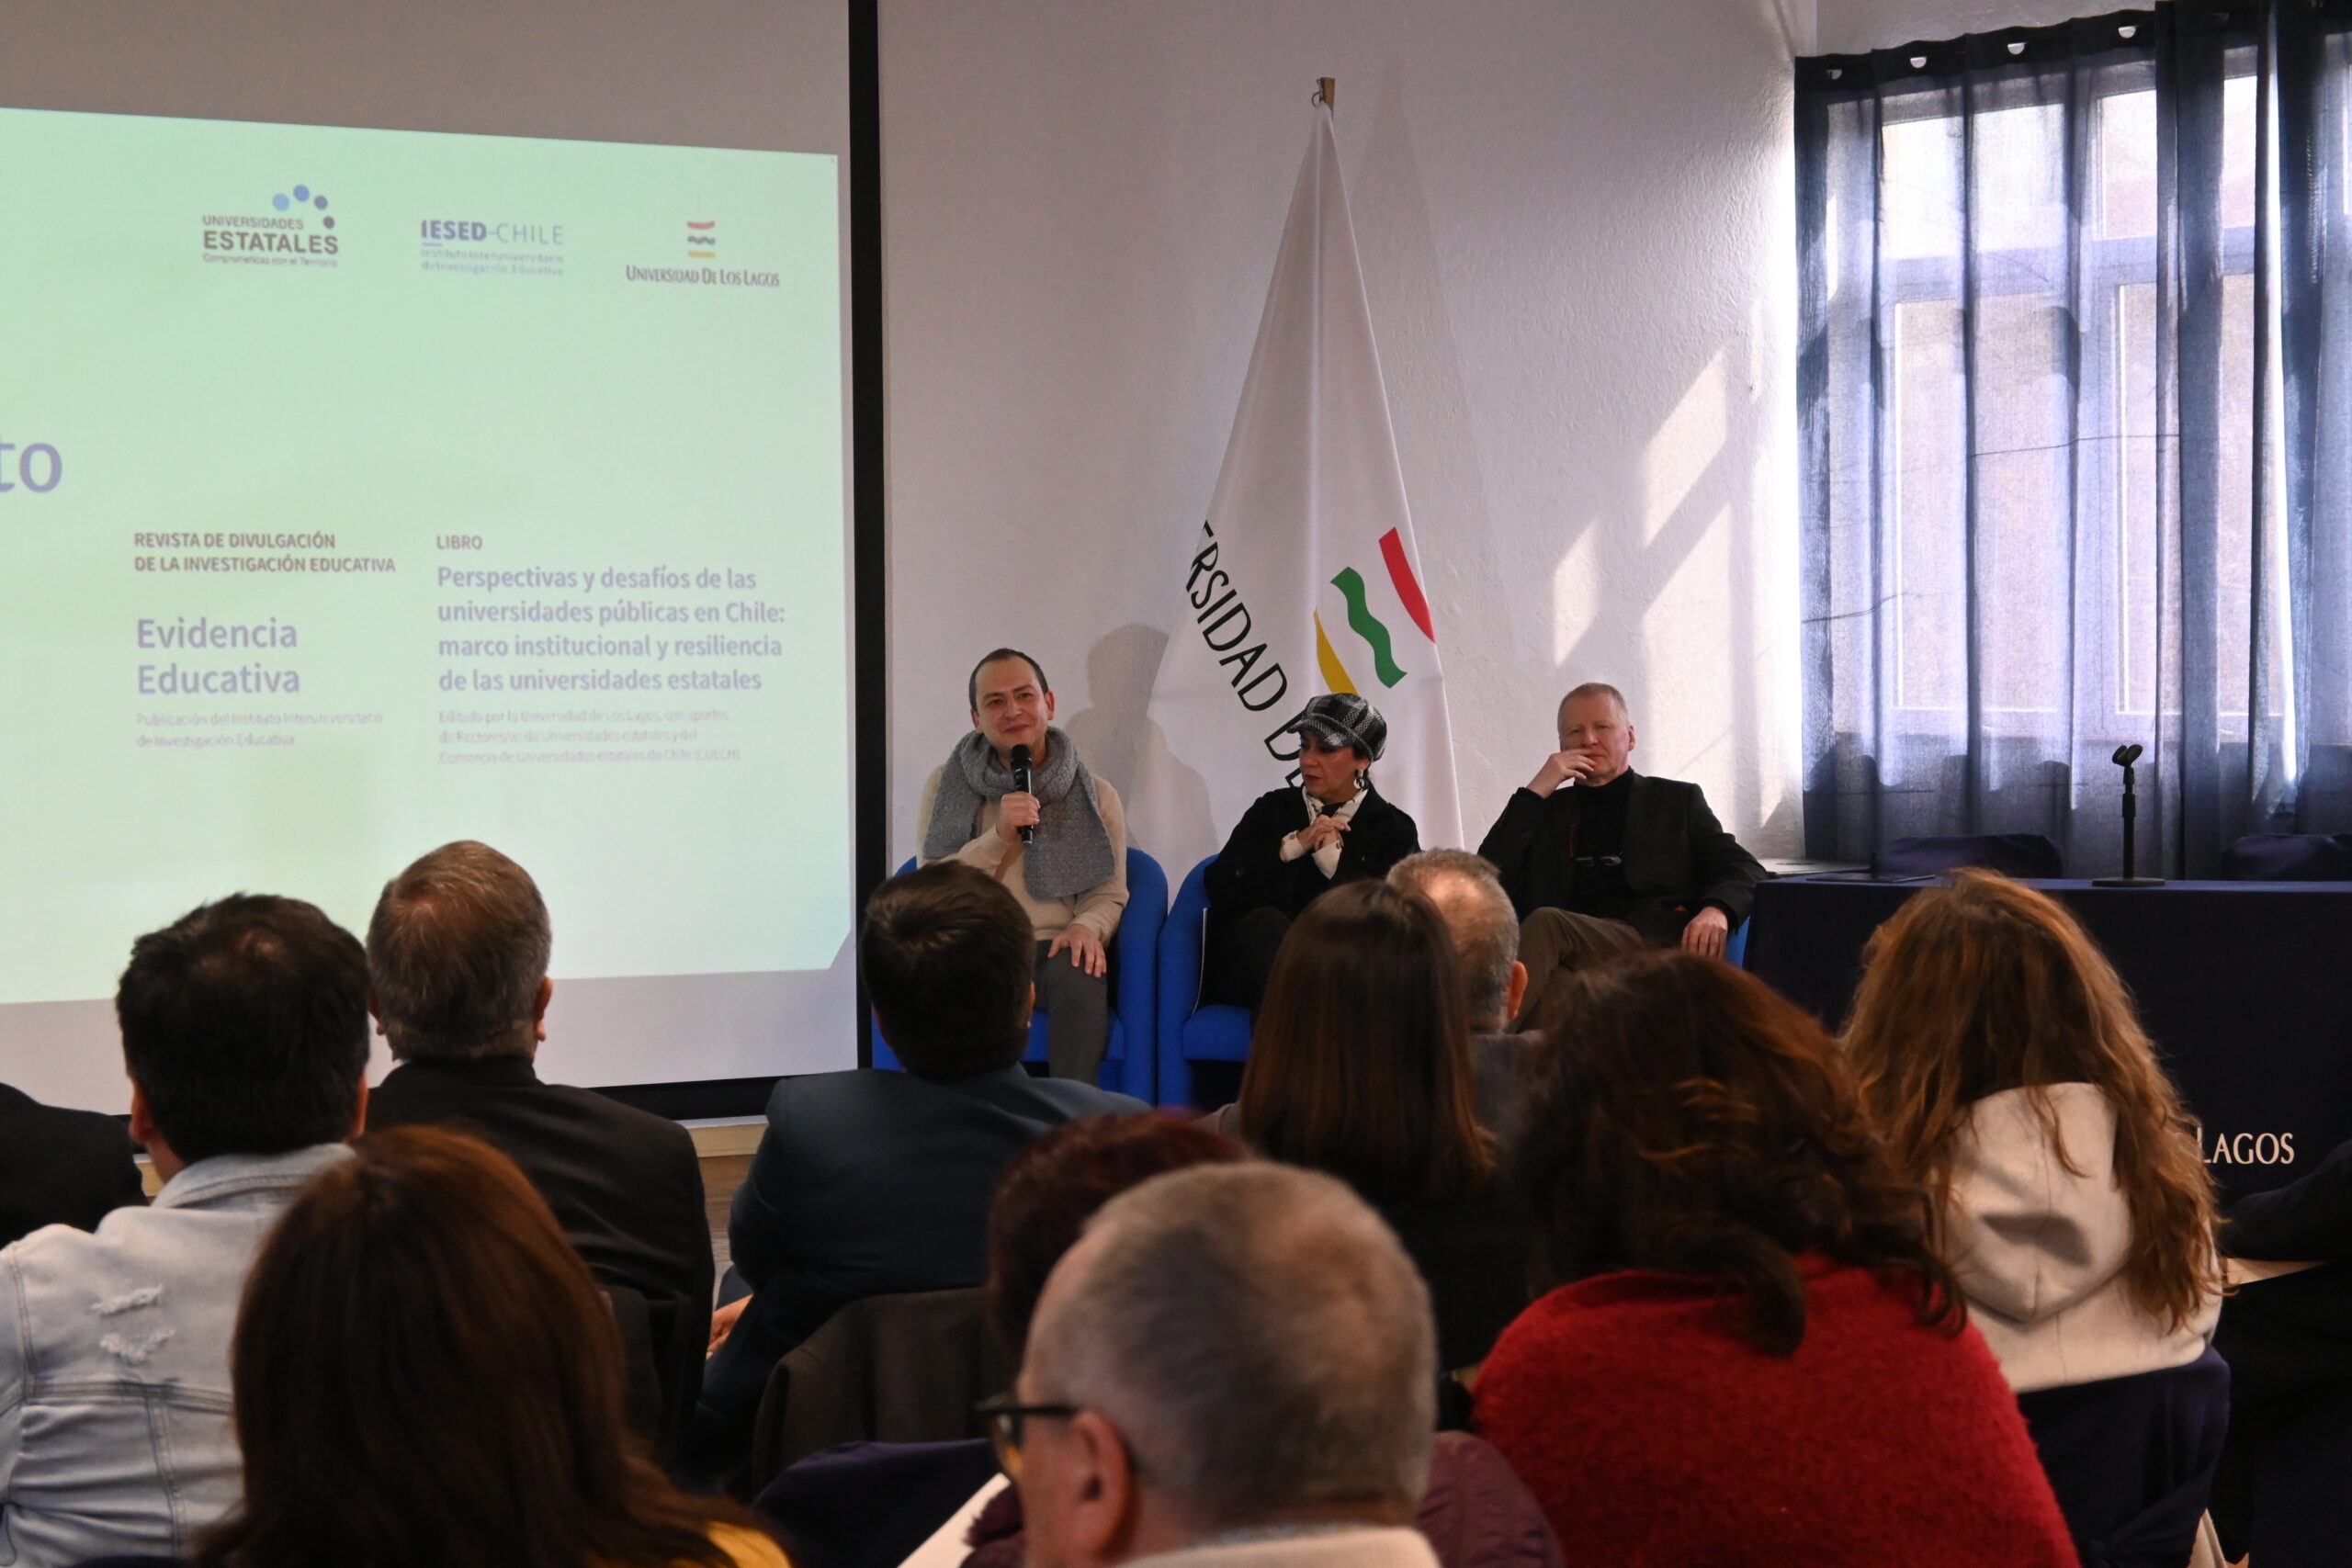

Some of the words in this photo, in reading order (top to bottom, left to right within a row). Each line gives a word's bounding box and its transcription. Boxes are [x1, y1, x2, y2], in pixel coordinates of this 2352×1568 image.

[202, 215, 304, 230] UNIVERSIDADES
[421, 220, 564, 245] IESED-CHILE
[203, 230, 338, 254] ESTATALES
[626, 265, 699, 284] UNIVERSIDAD
[702, 268, 718, 285] DE
[720, 269, 741, 286] LOS
[743, 270, 779, 287] LAGOS
[134, 533, 200, 548] REVISTA
[204, 533, 224, 548] DE
[230, 531, 335, 548] DIVULGACIÓN
[436, 536, 482, 549] LIBRO
[134, 557, 156, 571] DE
[160, 557, 180, 571] LA
[185, 554, 306, 572] INVESTIGACIÓN
[311, 557, 396, 572] EDUCATIVA
[437, 566, 578, 592] Perspectivas
[583, 571, 595, 592] y
[601, 564, 691, 589] desafíos
[696, 568, 721, 589] de
[727, 568, 756, 589] las
[437, 601, 594, 622] universidades
[599, 599, 689, 626] públicas
[695, 606, 720, 622] en
[726, 602, 786, 624] Chile:
[1186, 520, 1287, 711] RSIDAD
[137, 616, 298, 649] Evidencia
[438, 638, 509, 657] marco
[514, 635, 650, 657] institucional
[656, 640, 668, 660] y
[674, 635, 782, 657] resiliencia
[137, 662, 300, 694] Educativa
[439, 670, 467, 691] de
[472, 670, 503, 691] las
[510, 669, 662, 691] universidades
[667, 670, 762, 691] estatales
